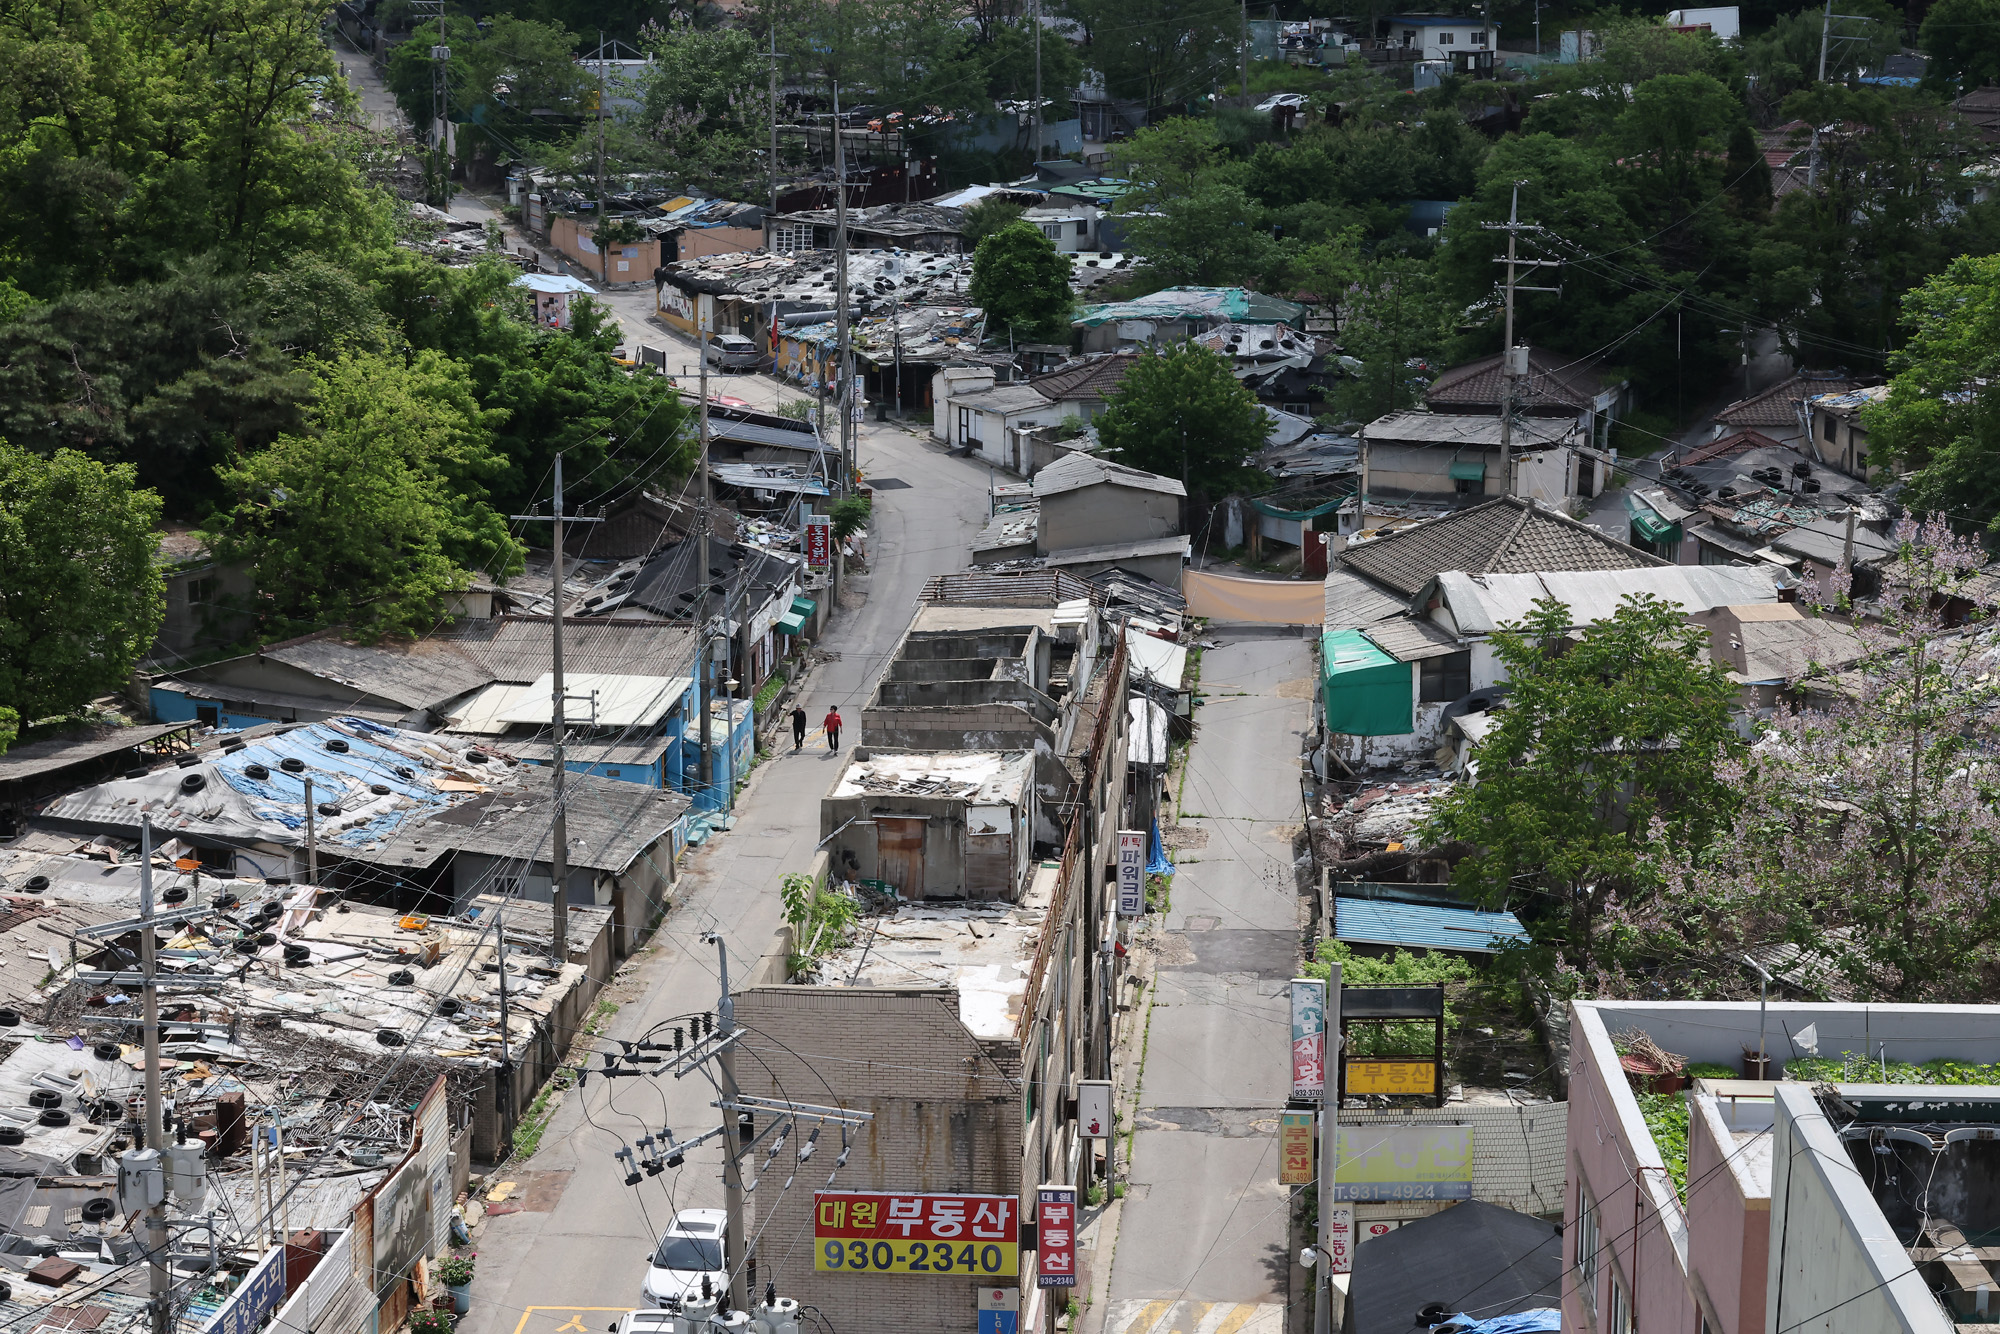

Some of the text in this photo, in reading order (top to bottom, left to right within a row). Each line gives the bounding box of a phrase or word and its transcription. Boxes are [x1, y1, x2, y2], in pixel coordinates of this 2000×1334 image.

[811, 526, 826, 558] 토종닭
[1121, 850, 1140, 911] 파워크린
[1363, 1064, 1432, 1084] 부동산
[1294, 1089, 1324, 1097] 932-3703
[1286, 1128, 1308, 1170] 부동산
[1282, 1173, 1311, 1182] 931-4924
[1042, 1192, 1071, 1202] 대원
[819, 1198, 1011, 1238] 대원 부동산
[1043, 1207, 1070, 1271] 부동산
[824, 1240, 1003, 1273] 930-2340
[1040, 1277, 1074, 1285] 930-2340
